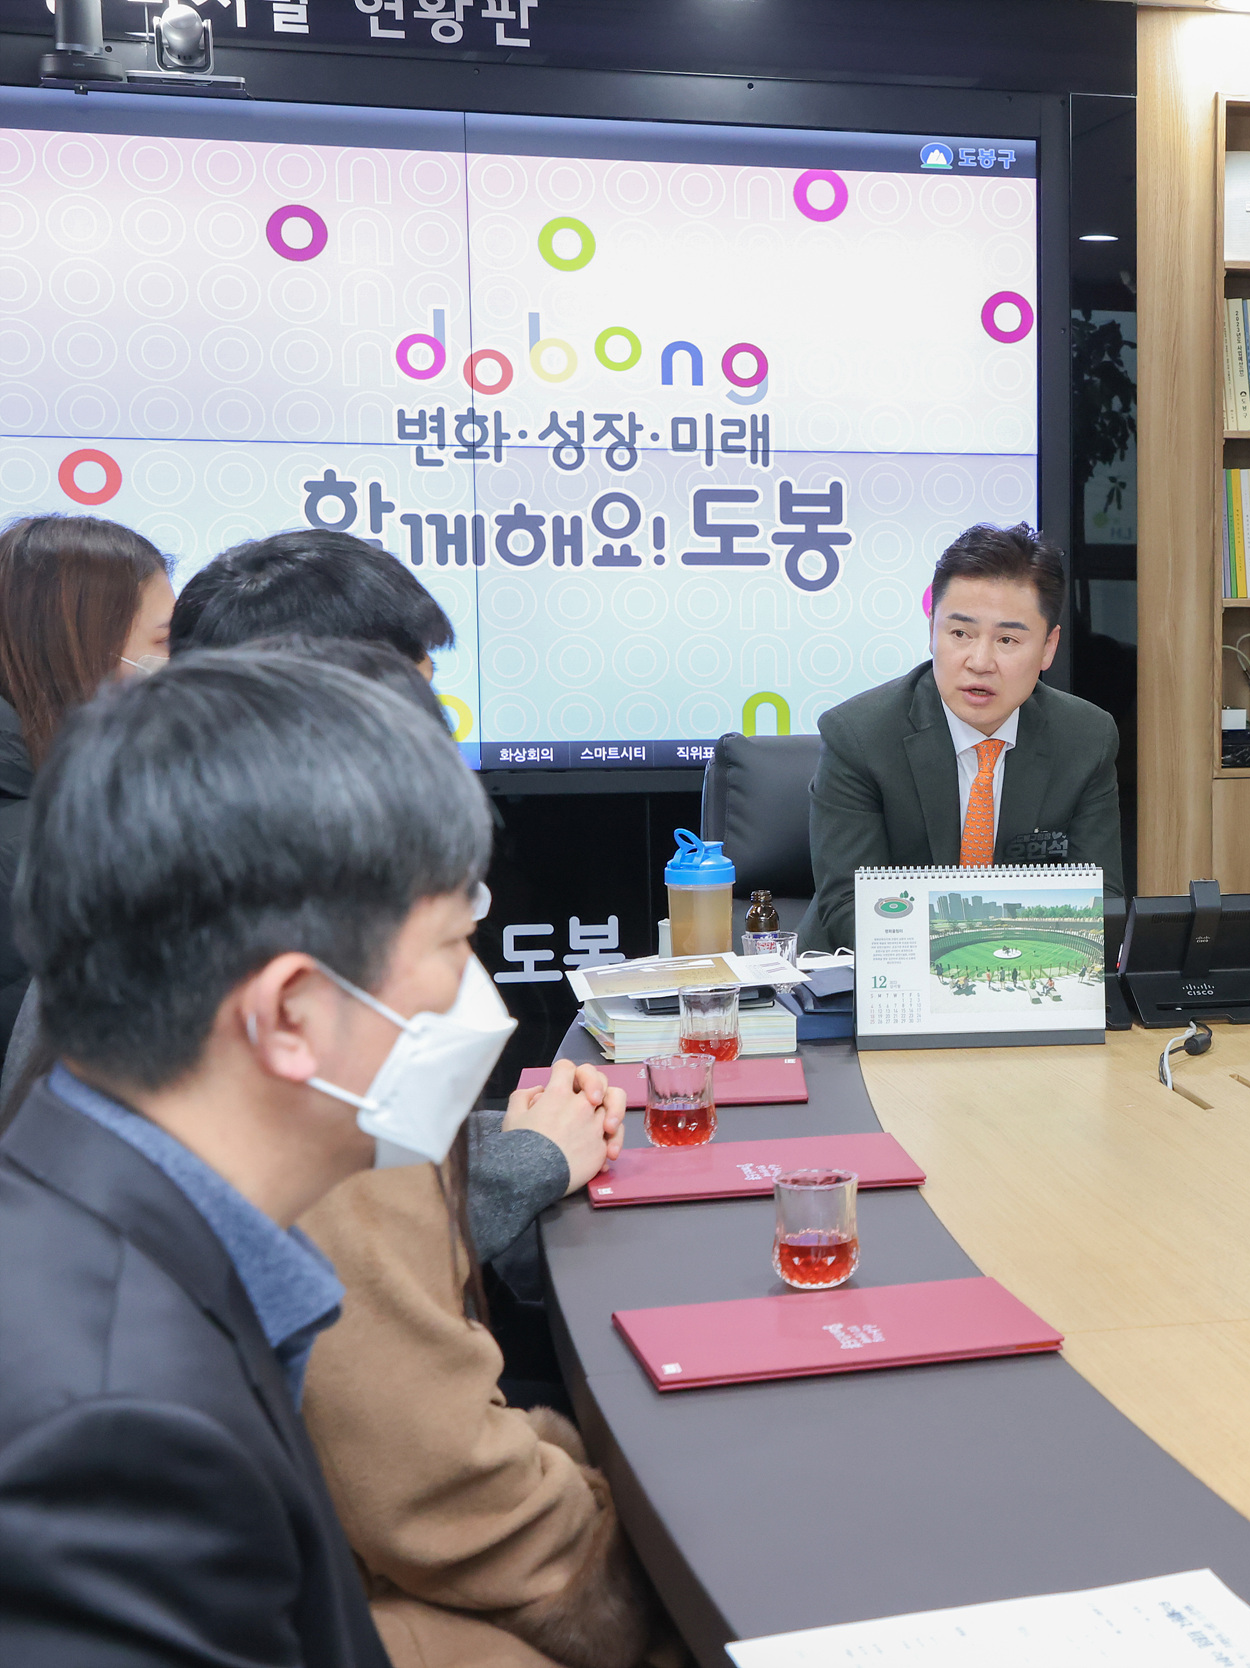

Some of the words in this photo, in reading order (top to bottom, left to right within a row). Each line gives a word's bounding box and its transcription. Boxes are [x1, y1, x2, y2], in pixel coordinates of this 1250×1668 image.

[957, 147, 1017, 170] 도봉구
[395, 308, 769, 406] dobong
[396, 406, 770, 472] 변화·성장·미래
[302, 468, 667, 568] 함께해요!
[680, 480, 853, 592] 도봉
[499, 747, 554, 762] 화상회의
[580, 746, 646, 761] 스마트시티
[676, 746, 715, 761] 직위표
[493, 915, 626, 984] 도봉
[872, 976, 887, 989] 12
